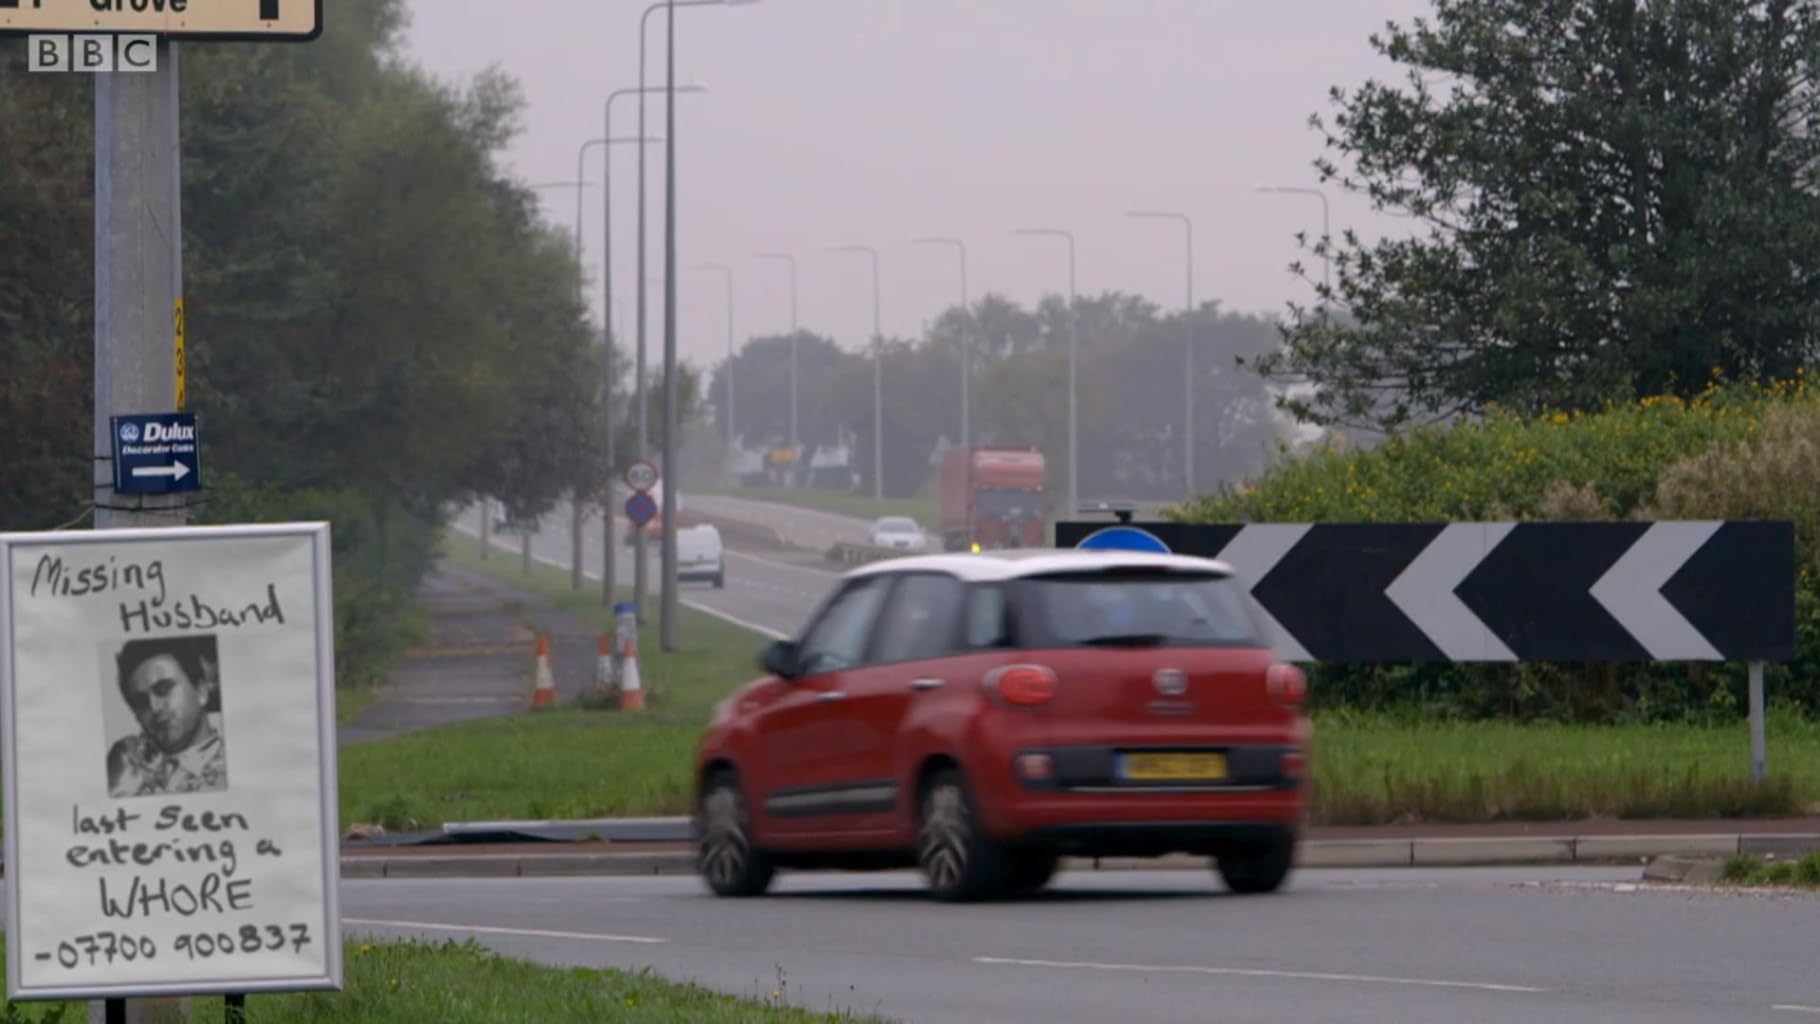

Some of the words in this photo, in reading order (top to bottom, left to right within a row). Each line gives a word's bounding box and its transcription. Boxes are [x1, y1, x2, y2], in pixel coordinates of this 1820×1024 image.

[143, 422, 194, 442] Dulux
[31, 554, 166, 607] Missing
[120, 583, 285, 632] Husband
[73, 804, 141, 834] last
[65, 837, 237, 877] entering
[256, 838, 282, 857] a
[99, 872, 254, 918] WHORE
[173, 923, 311, 960] 900837
